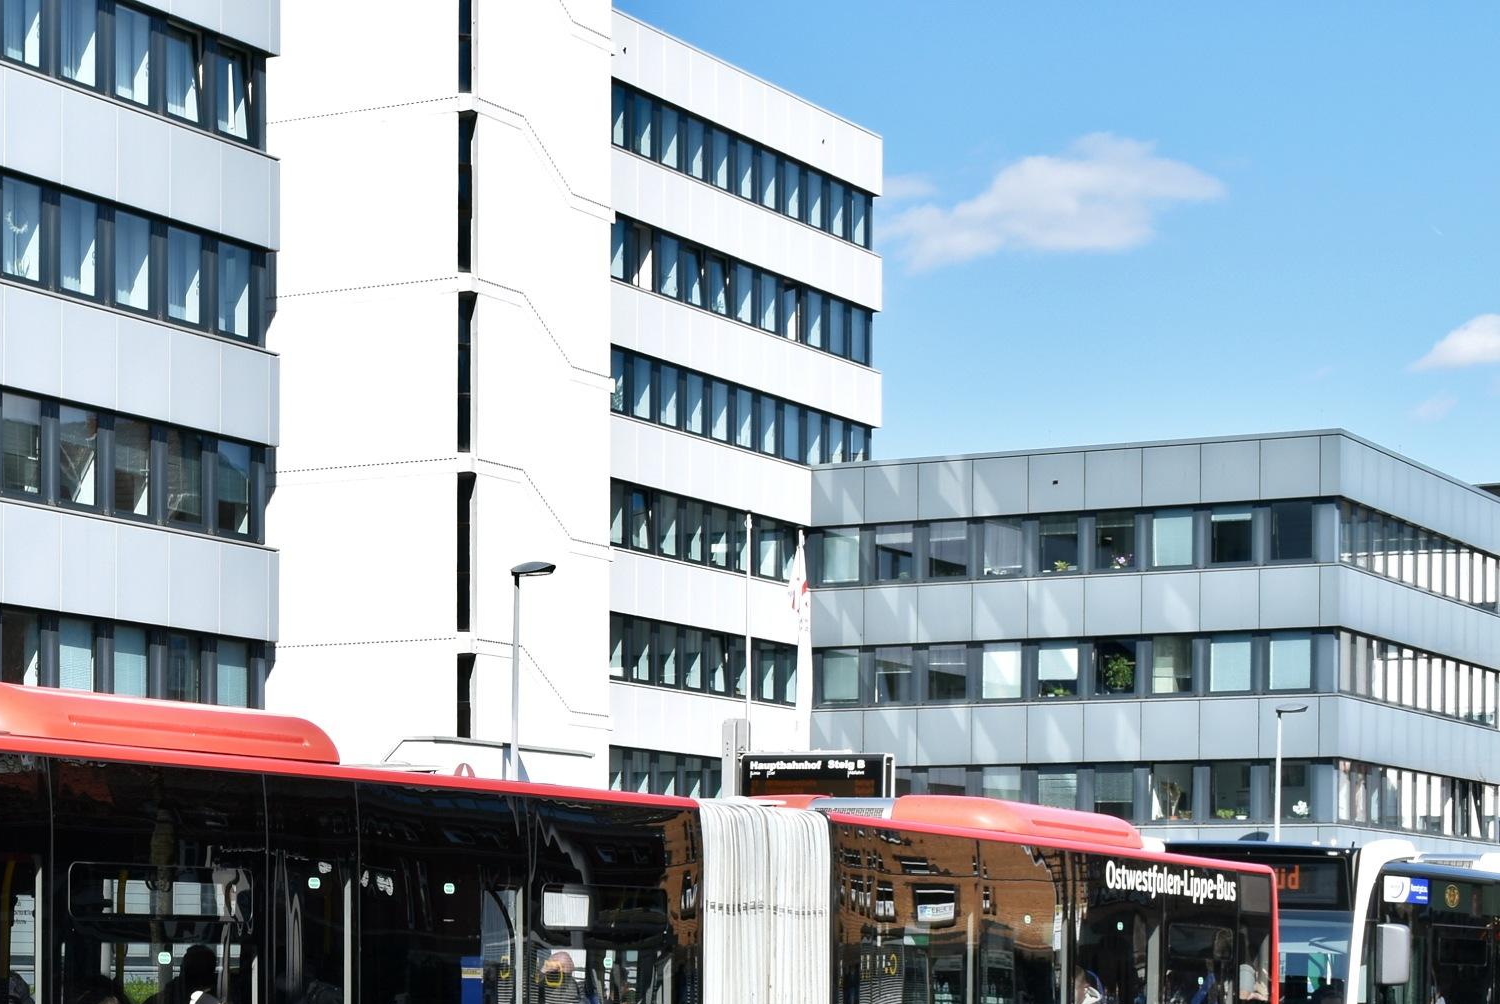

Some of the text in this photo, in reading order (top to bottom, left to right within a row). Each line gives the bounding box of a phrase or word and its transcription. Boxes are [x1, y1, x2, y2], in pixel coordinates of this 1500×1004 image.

[750, 759, 866, 771] Hauptbahnhof Steig B
[1105, 860, 1237, 904] Ostwestfalen-Lippe-Bus
